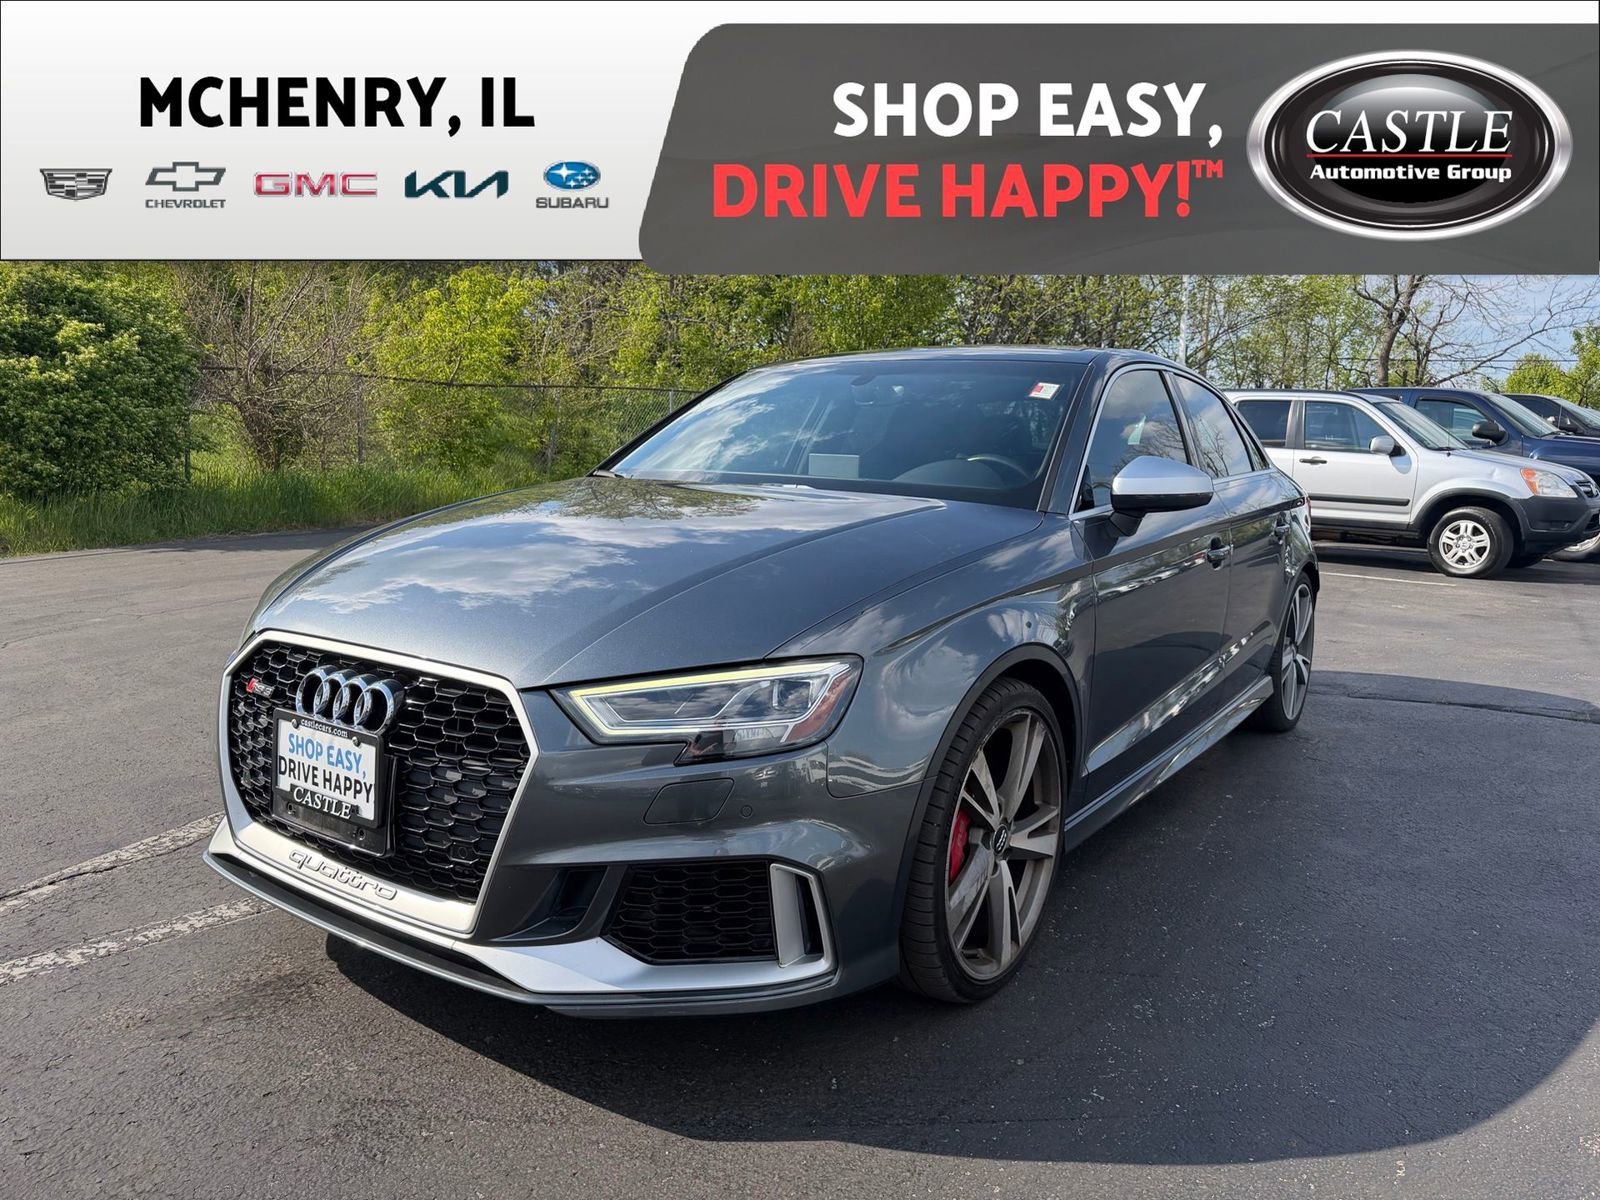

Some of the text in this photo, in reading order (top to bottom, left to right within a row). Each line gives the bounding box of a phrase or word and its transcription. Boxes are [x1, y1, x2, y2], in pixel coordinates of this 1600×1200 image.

[300, 718, 348, 738] castlecars.com
[279, 755, 373, 803] DRIVE HAPPY
[288, 733, 367, 779] SHOP EASY,
[293, 786, 352, 820] CASTLE
[289, 849, 398, 900] quattro
